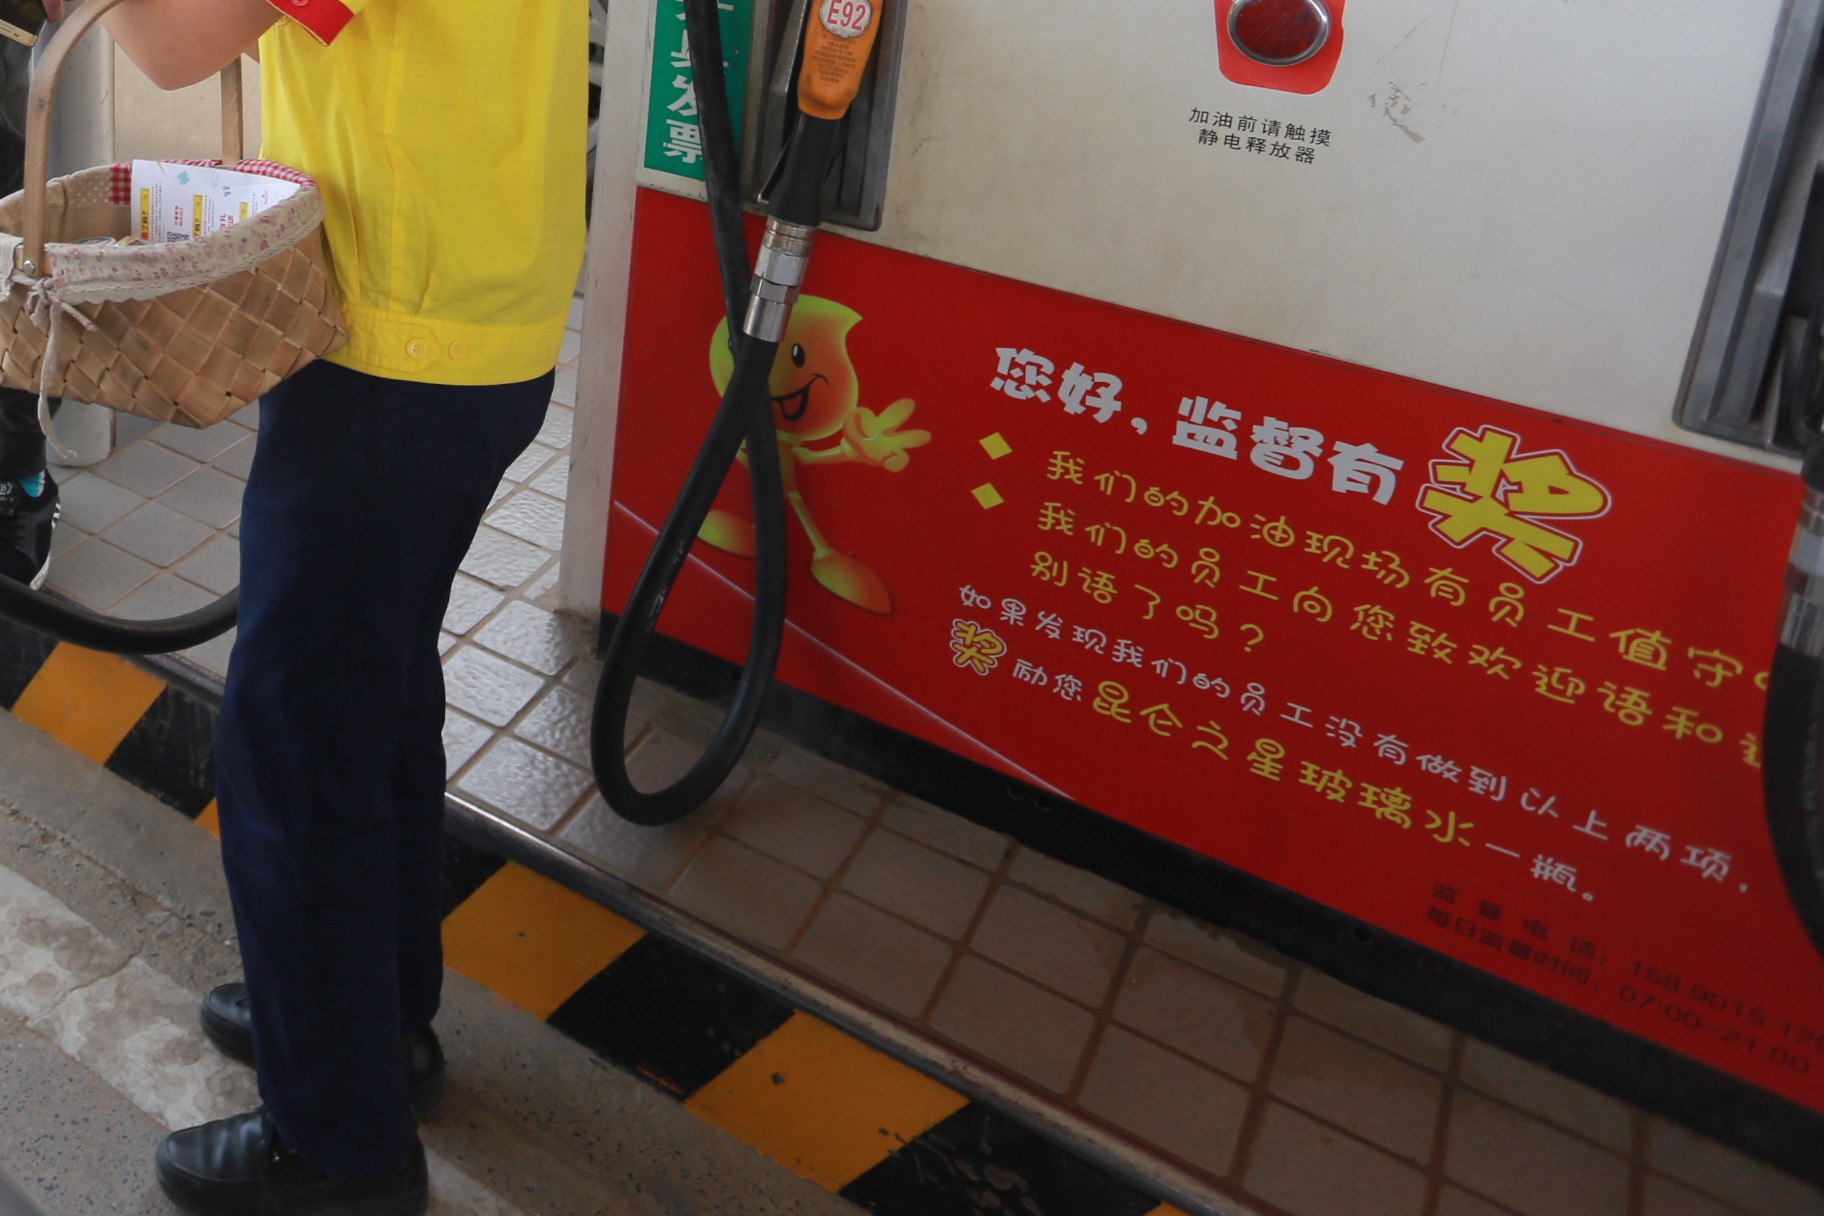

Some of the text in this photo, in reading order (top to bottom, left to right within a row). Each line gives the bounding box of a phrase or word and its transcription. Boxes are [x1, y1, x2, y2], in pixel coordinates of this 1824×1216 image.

[1188, 106, 1332, 147] 加油前请触摸
[1197, 128, 1315, 164] 静电释放器
